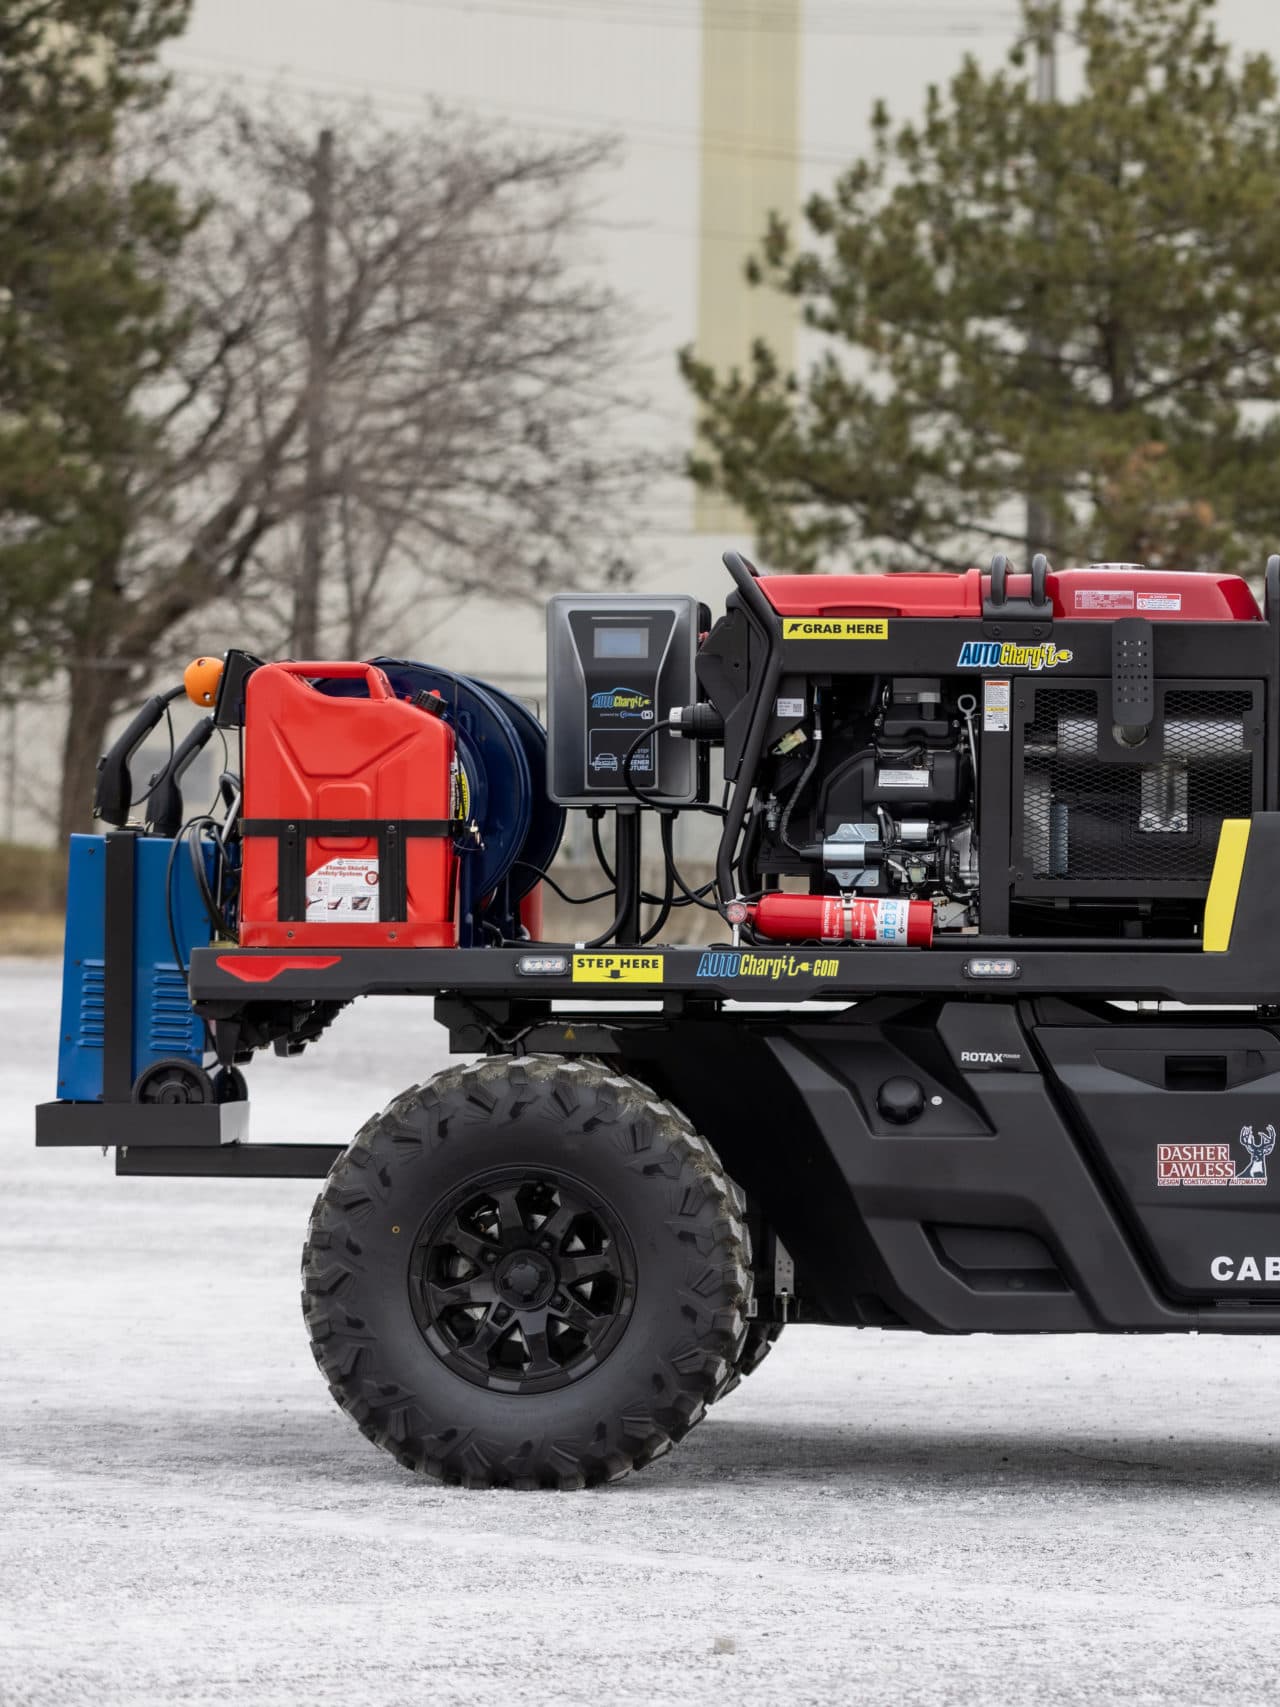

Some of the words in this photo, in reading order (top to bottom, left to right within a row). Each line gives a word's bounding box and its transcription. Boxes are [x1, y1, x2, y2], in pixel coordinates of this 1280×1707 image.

[803, 624, 842, 634] GRAB
[846, 624, 884, 634] HERE
[577, 958, 615, 969] STEP
[620, 958, 659, 969] HERE
[961, 1052, 1003, 1063] ROTAX
[1160, 1146, 1228, 1161] DASHER
[1160, 1162, 1235, 1178] LAWLESS
